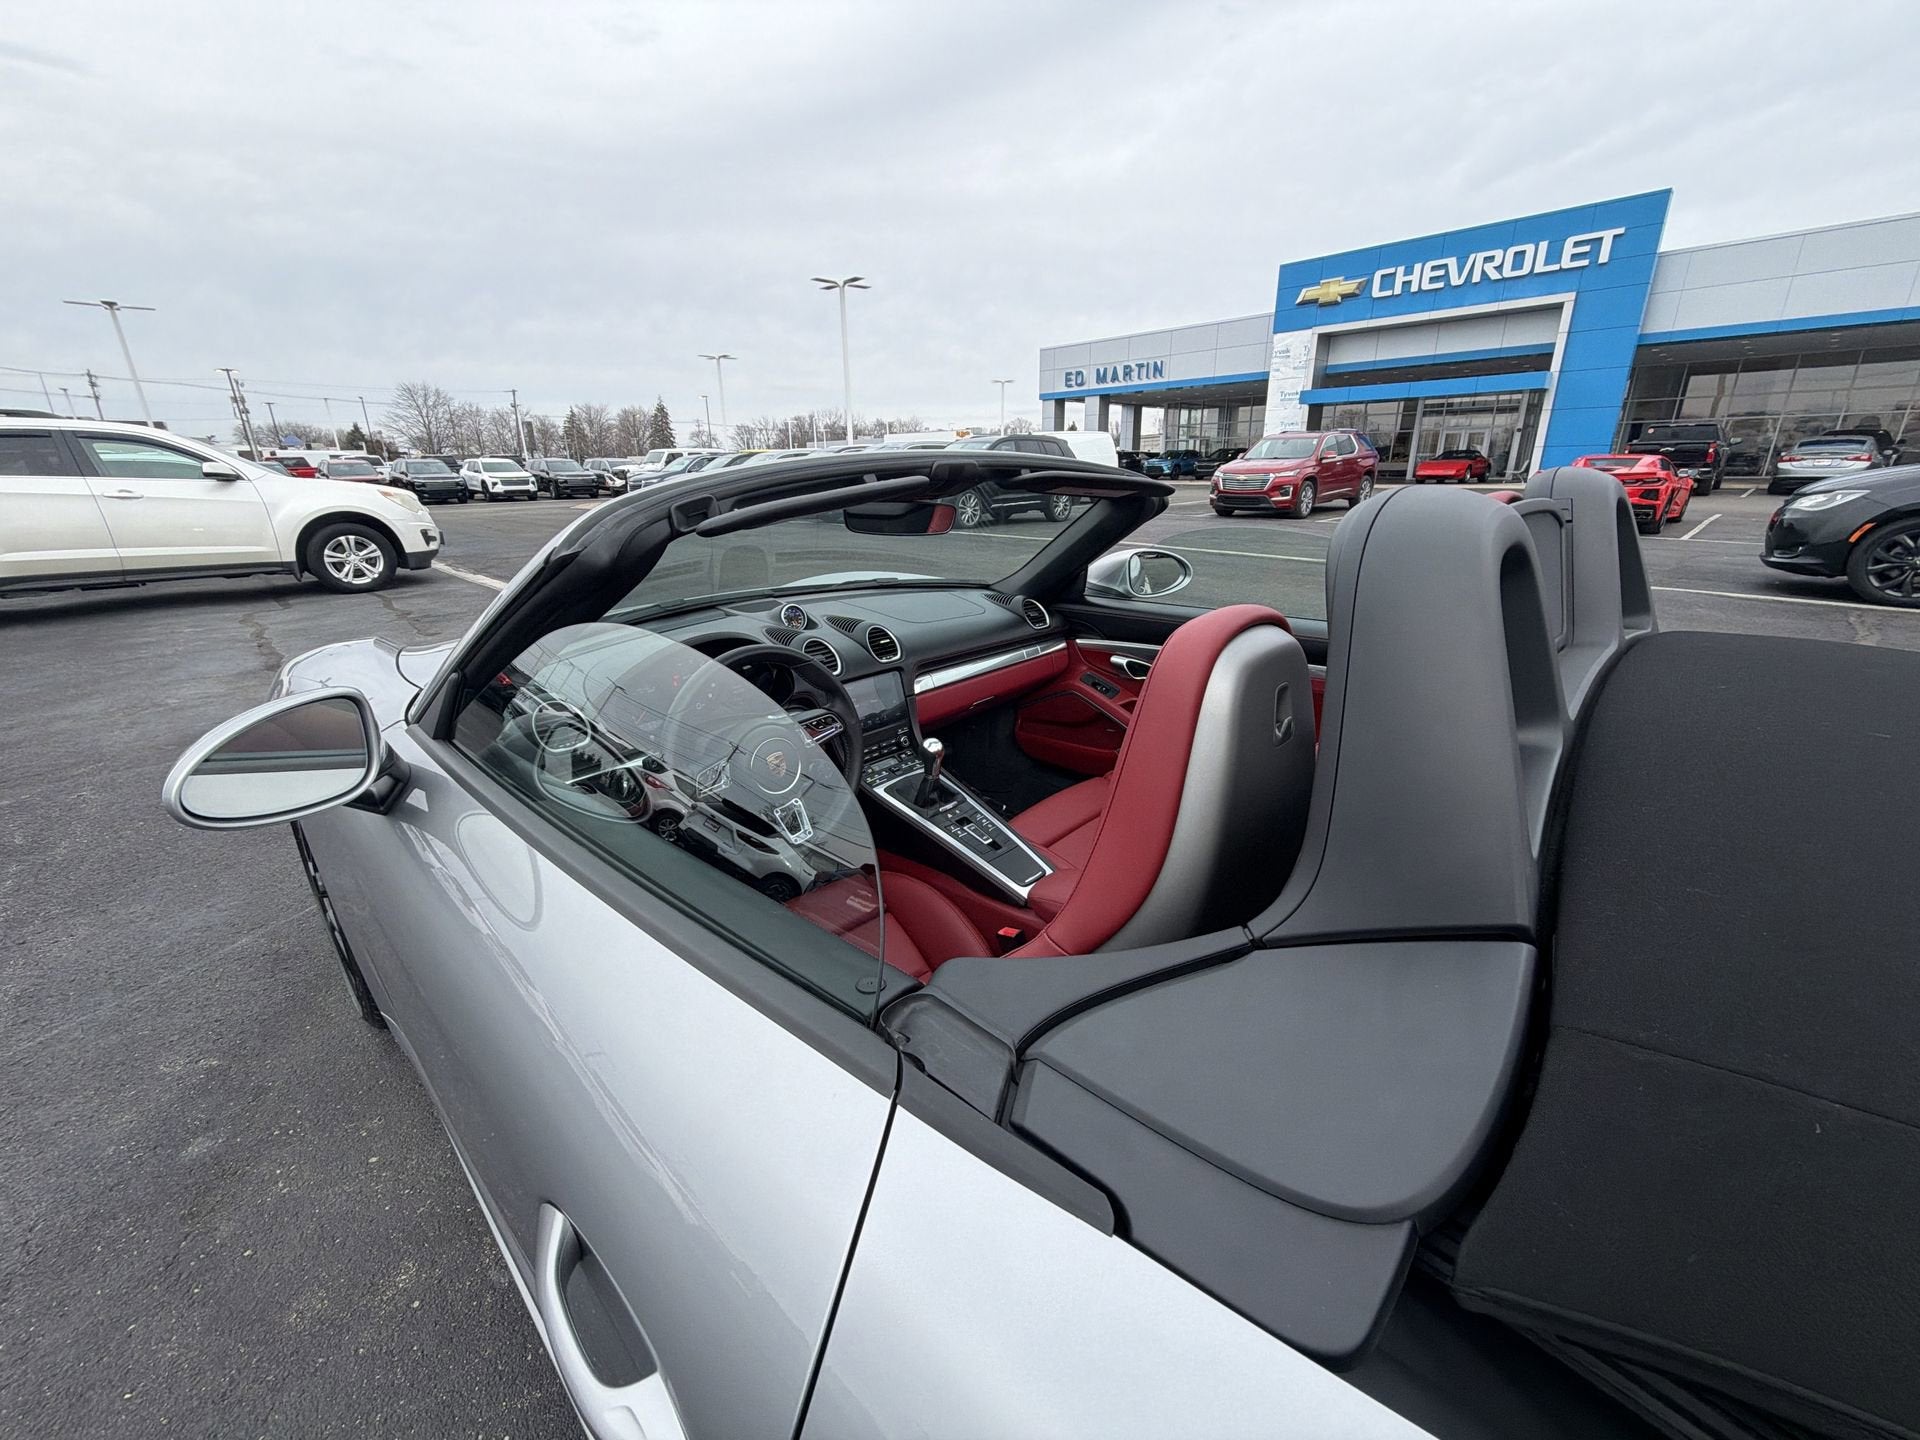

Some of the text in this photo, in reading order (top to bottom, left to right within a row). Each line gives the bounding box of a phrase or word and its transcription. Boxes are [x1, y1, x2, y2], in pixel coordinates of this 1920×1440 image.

[1371, 226, 1626, 299] CHEVROLET
[1064, 360, 1164, 388] ED MARTIN
